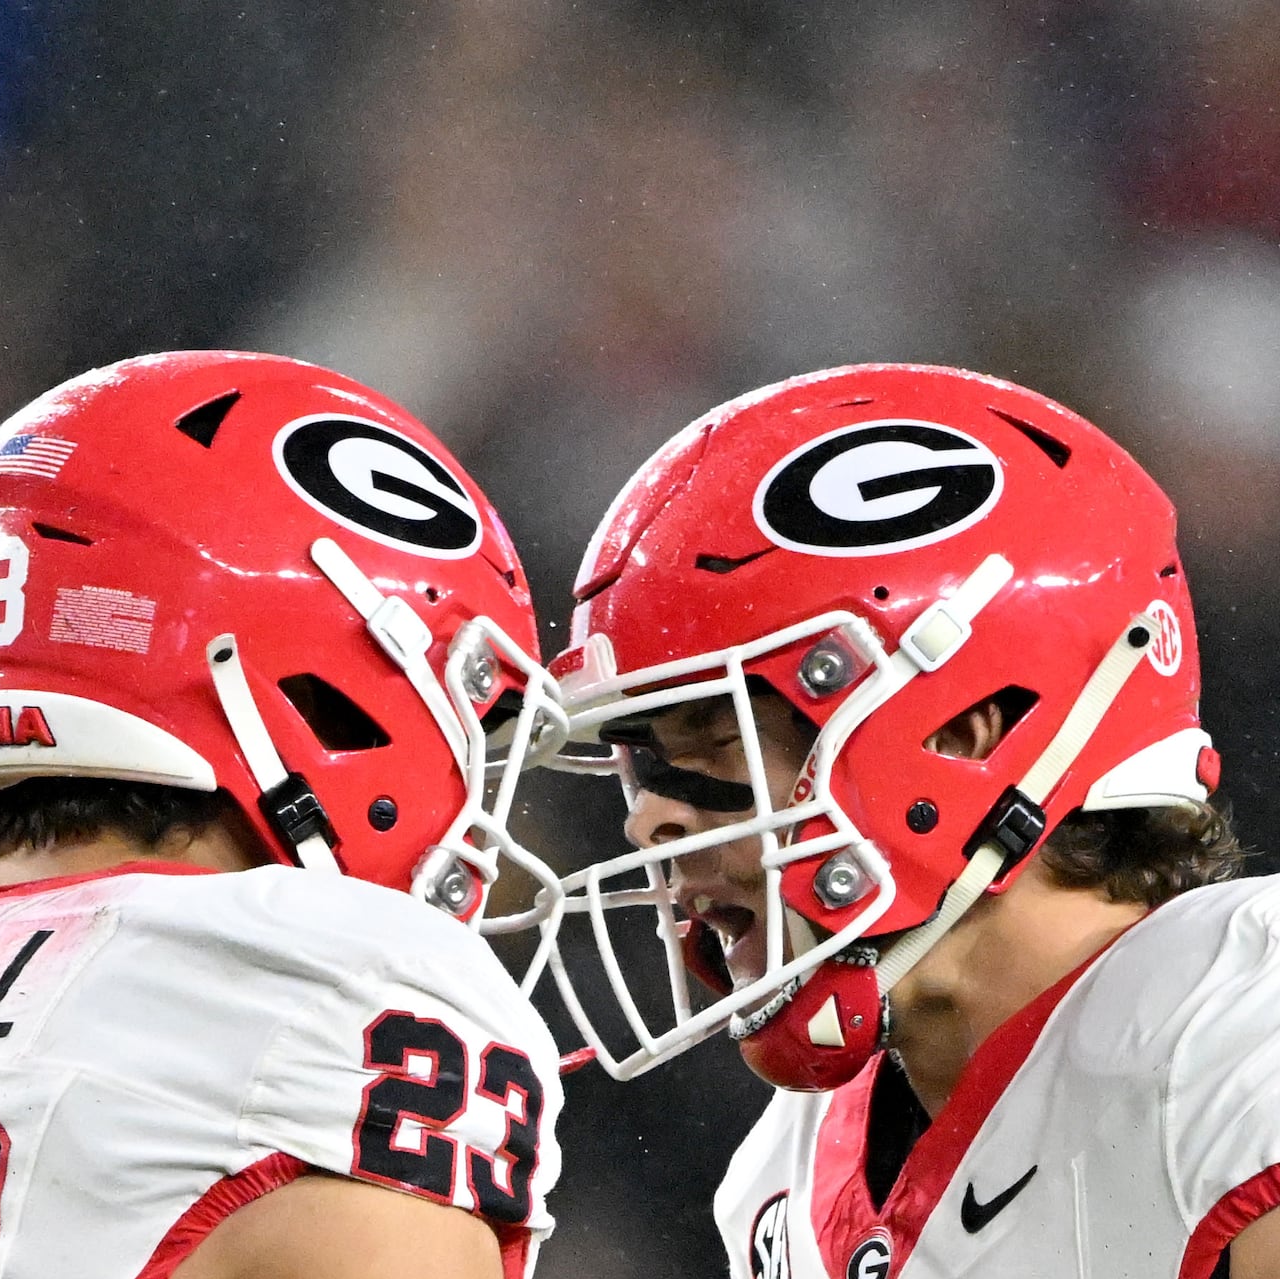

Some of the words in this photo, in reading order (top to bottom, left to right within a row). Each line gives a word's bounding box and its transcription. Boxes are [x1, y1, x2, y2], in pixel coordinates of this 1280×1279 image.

[283, 420, 477, 552] G
[763, 425, 995, 547] G
[82, 584, 133, 598] WARNING
[351, 1009, 544, 1226] 23
